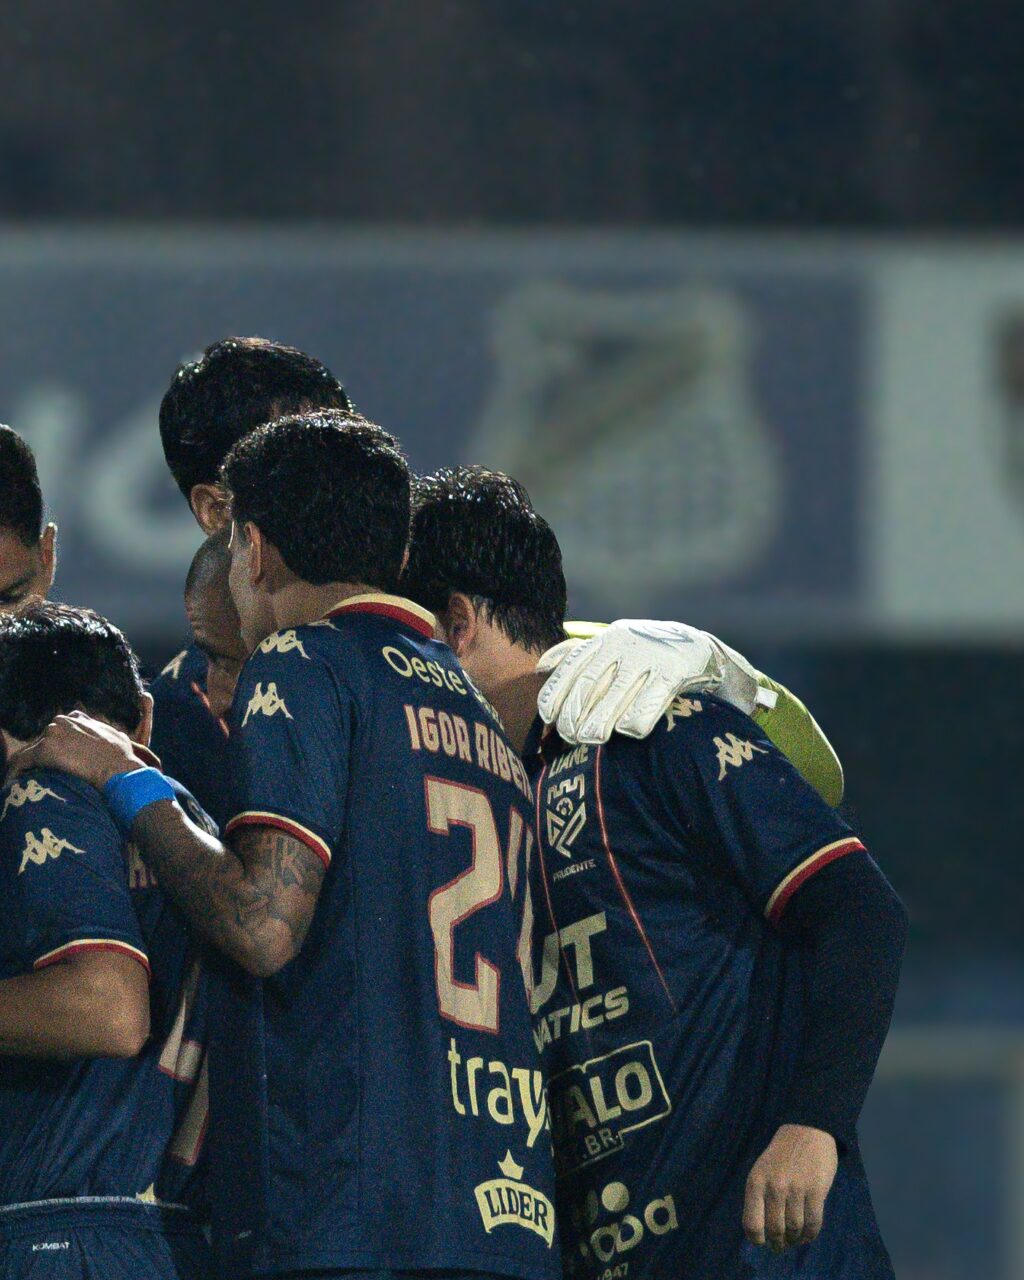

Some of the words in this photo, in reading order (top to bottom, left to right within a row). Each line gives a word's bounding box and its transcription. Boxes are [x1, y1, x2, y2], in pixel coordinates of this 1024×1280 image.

[382, 645, 468, 696] Oeste
[404, 703, 473, 763] IGOR
[553, 859, 597, 882] PRUDENTE
[483, 1187, 548, 1230] LIDER
